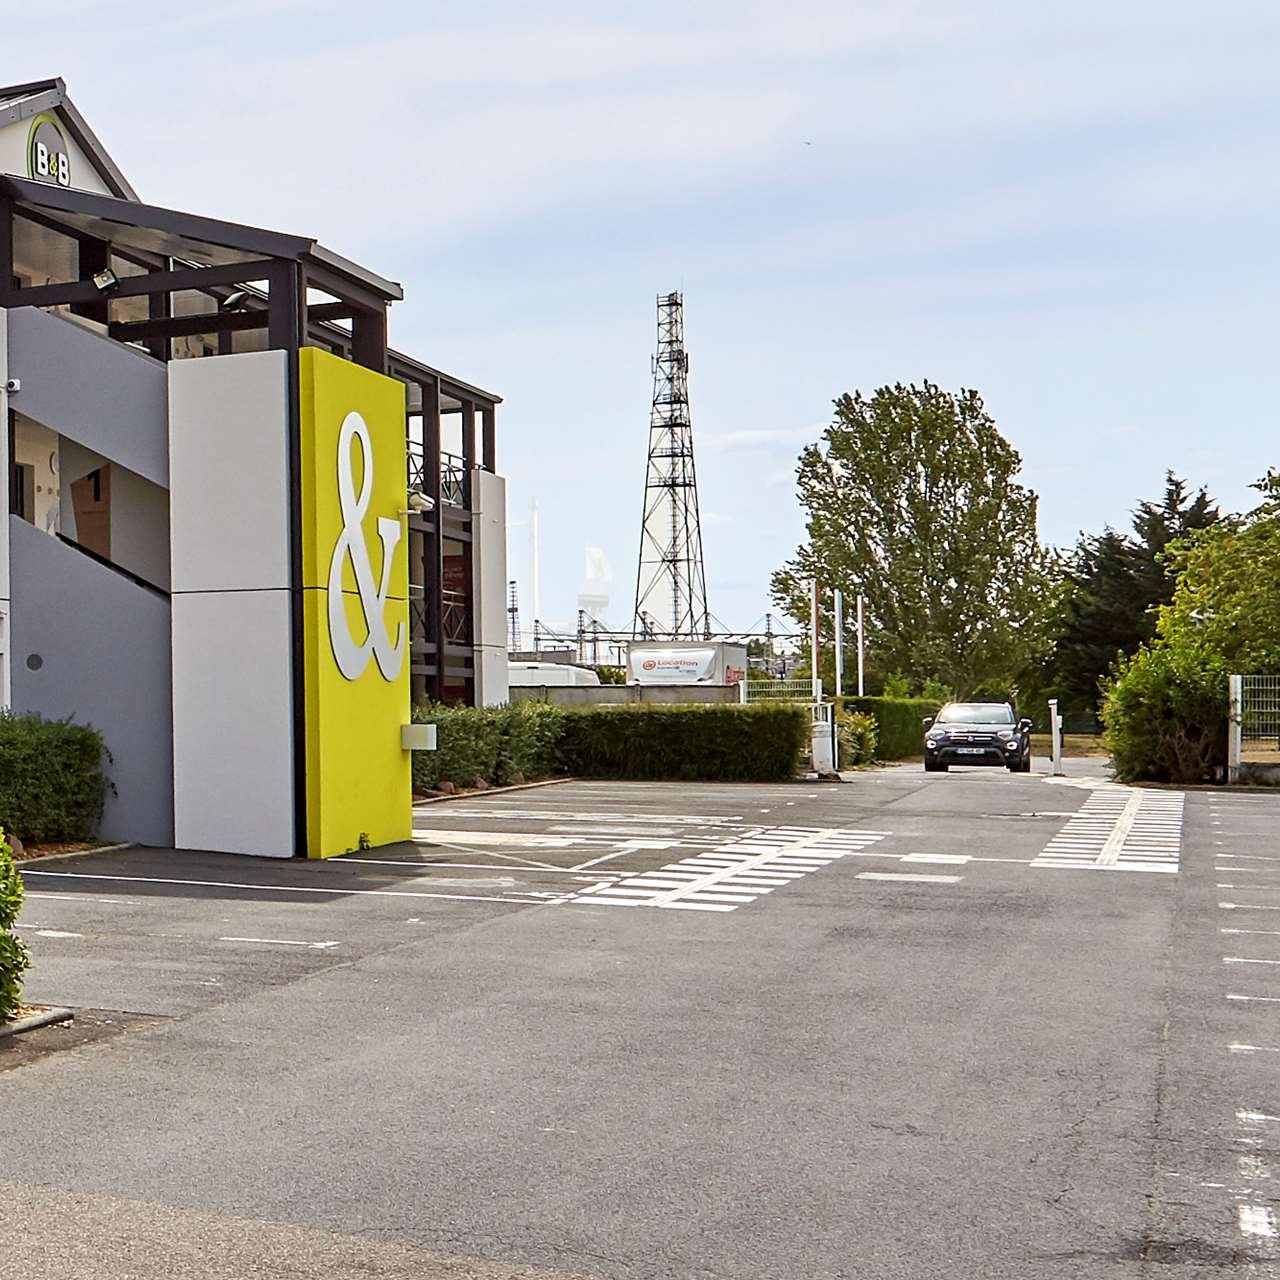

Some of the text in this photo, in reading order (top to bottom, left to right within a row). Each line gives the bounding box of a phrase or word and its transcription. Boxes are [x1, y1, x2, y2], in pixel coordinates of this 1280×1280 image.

[35, 142, 70, 187] B&B
[327, 410, 405, 683] &
[657, 659, 698, 667] Location
